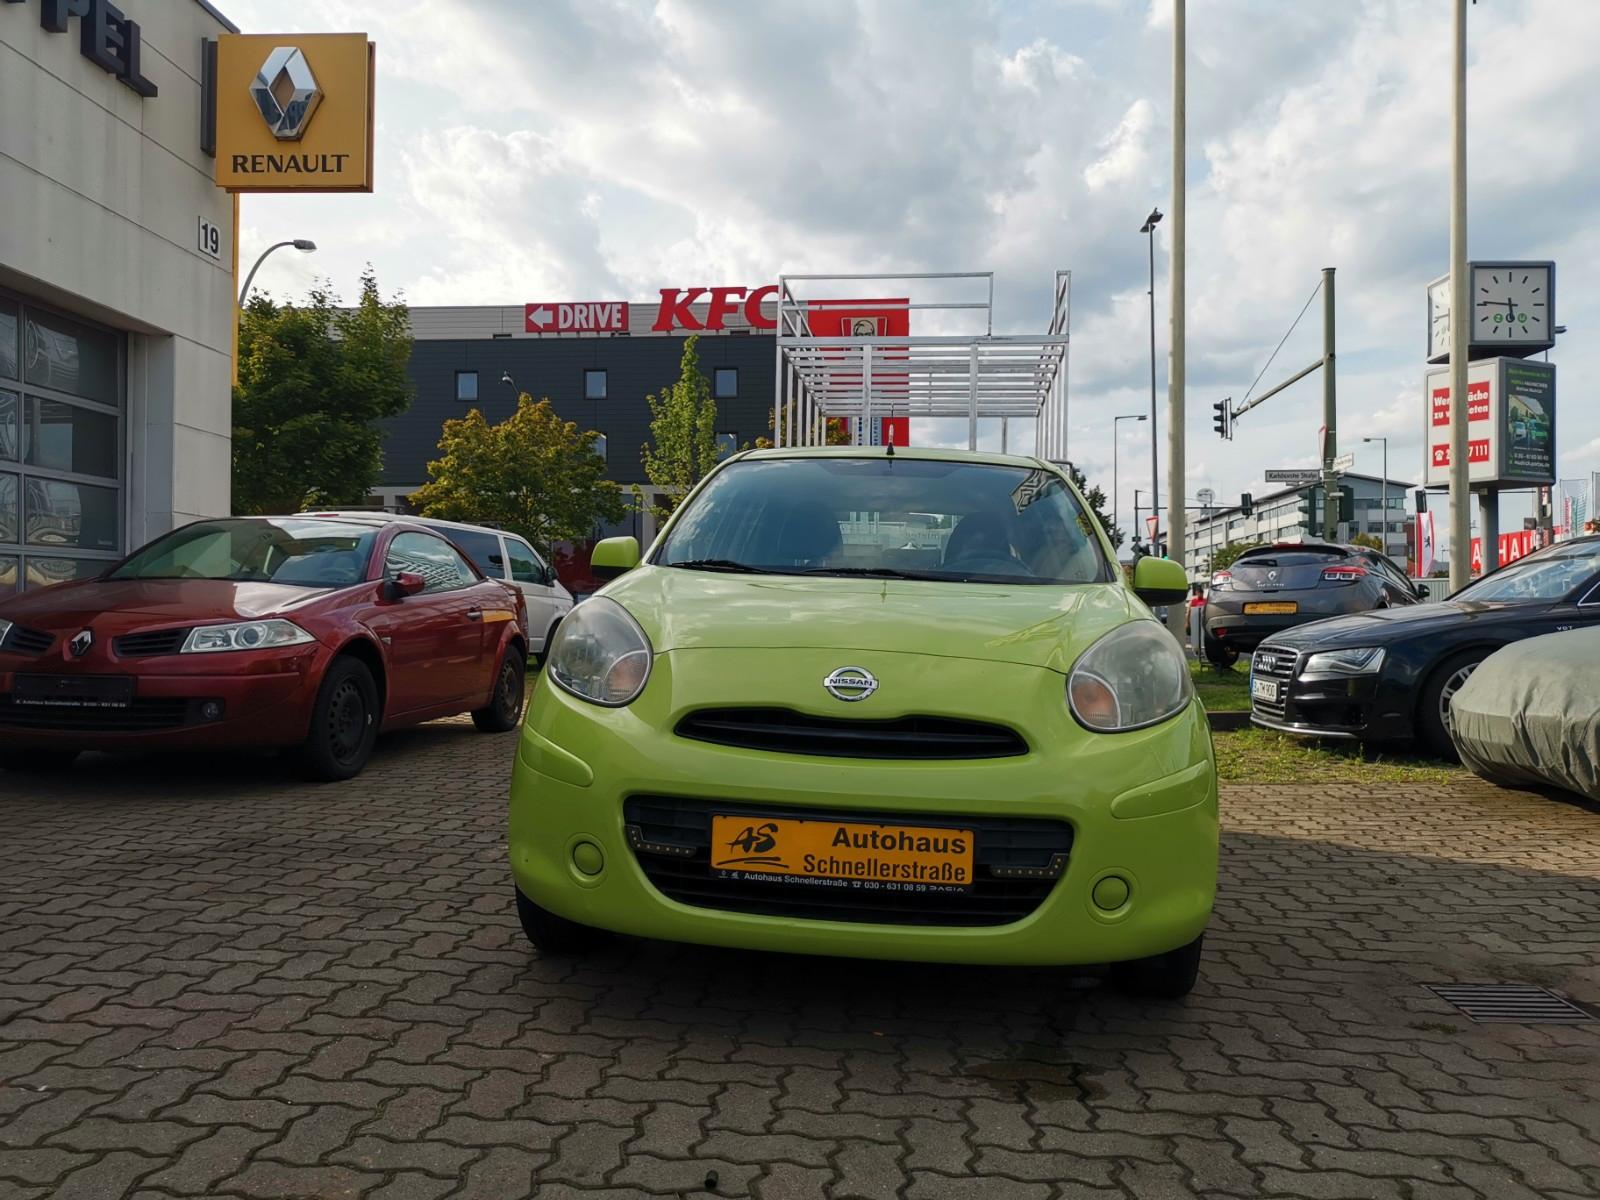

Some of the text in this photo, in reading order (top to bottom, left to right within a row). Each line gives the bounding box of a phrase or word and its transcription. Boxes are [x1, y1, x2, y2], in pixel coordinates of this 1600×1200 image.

[232, 153, 350, 173] RENAULT
[202, 223, 219, 254] 19
[558, 303, 622, 330] DRIVE
[651, 285, 784, 332] KFC
[1434, 390, 1489, 407] Weräche
[829, 678, 873, 687] NISSAN
[832, 826, 967, 855] Autohaus
[744, 872, 783, 882] Autohaus
[784, 874, 848, 888] Schnellerstraße
[864, 881, 880, 889] 030
[886, 882, 902, 891] 631
[915, 884, 926, 892] 59
[803, 854, 966, 883] Schnellerstraße
